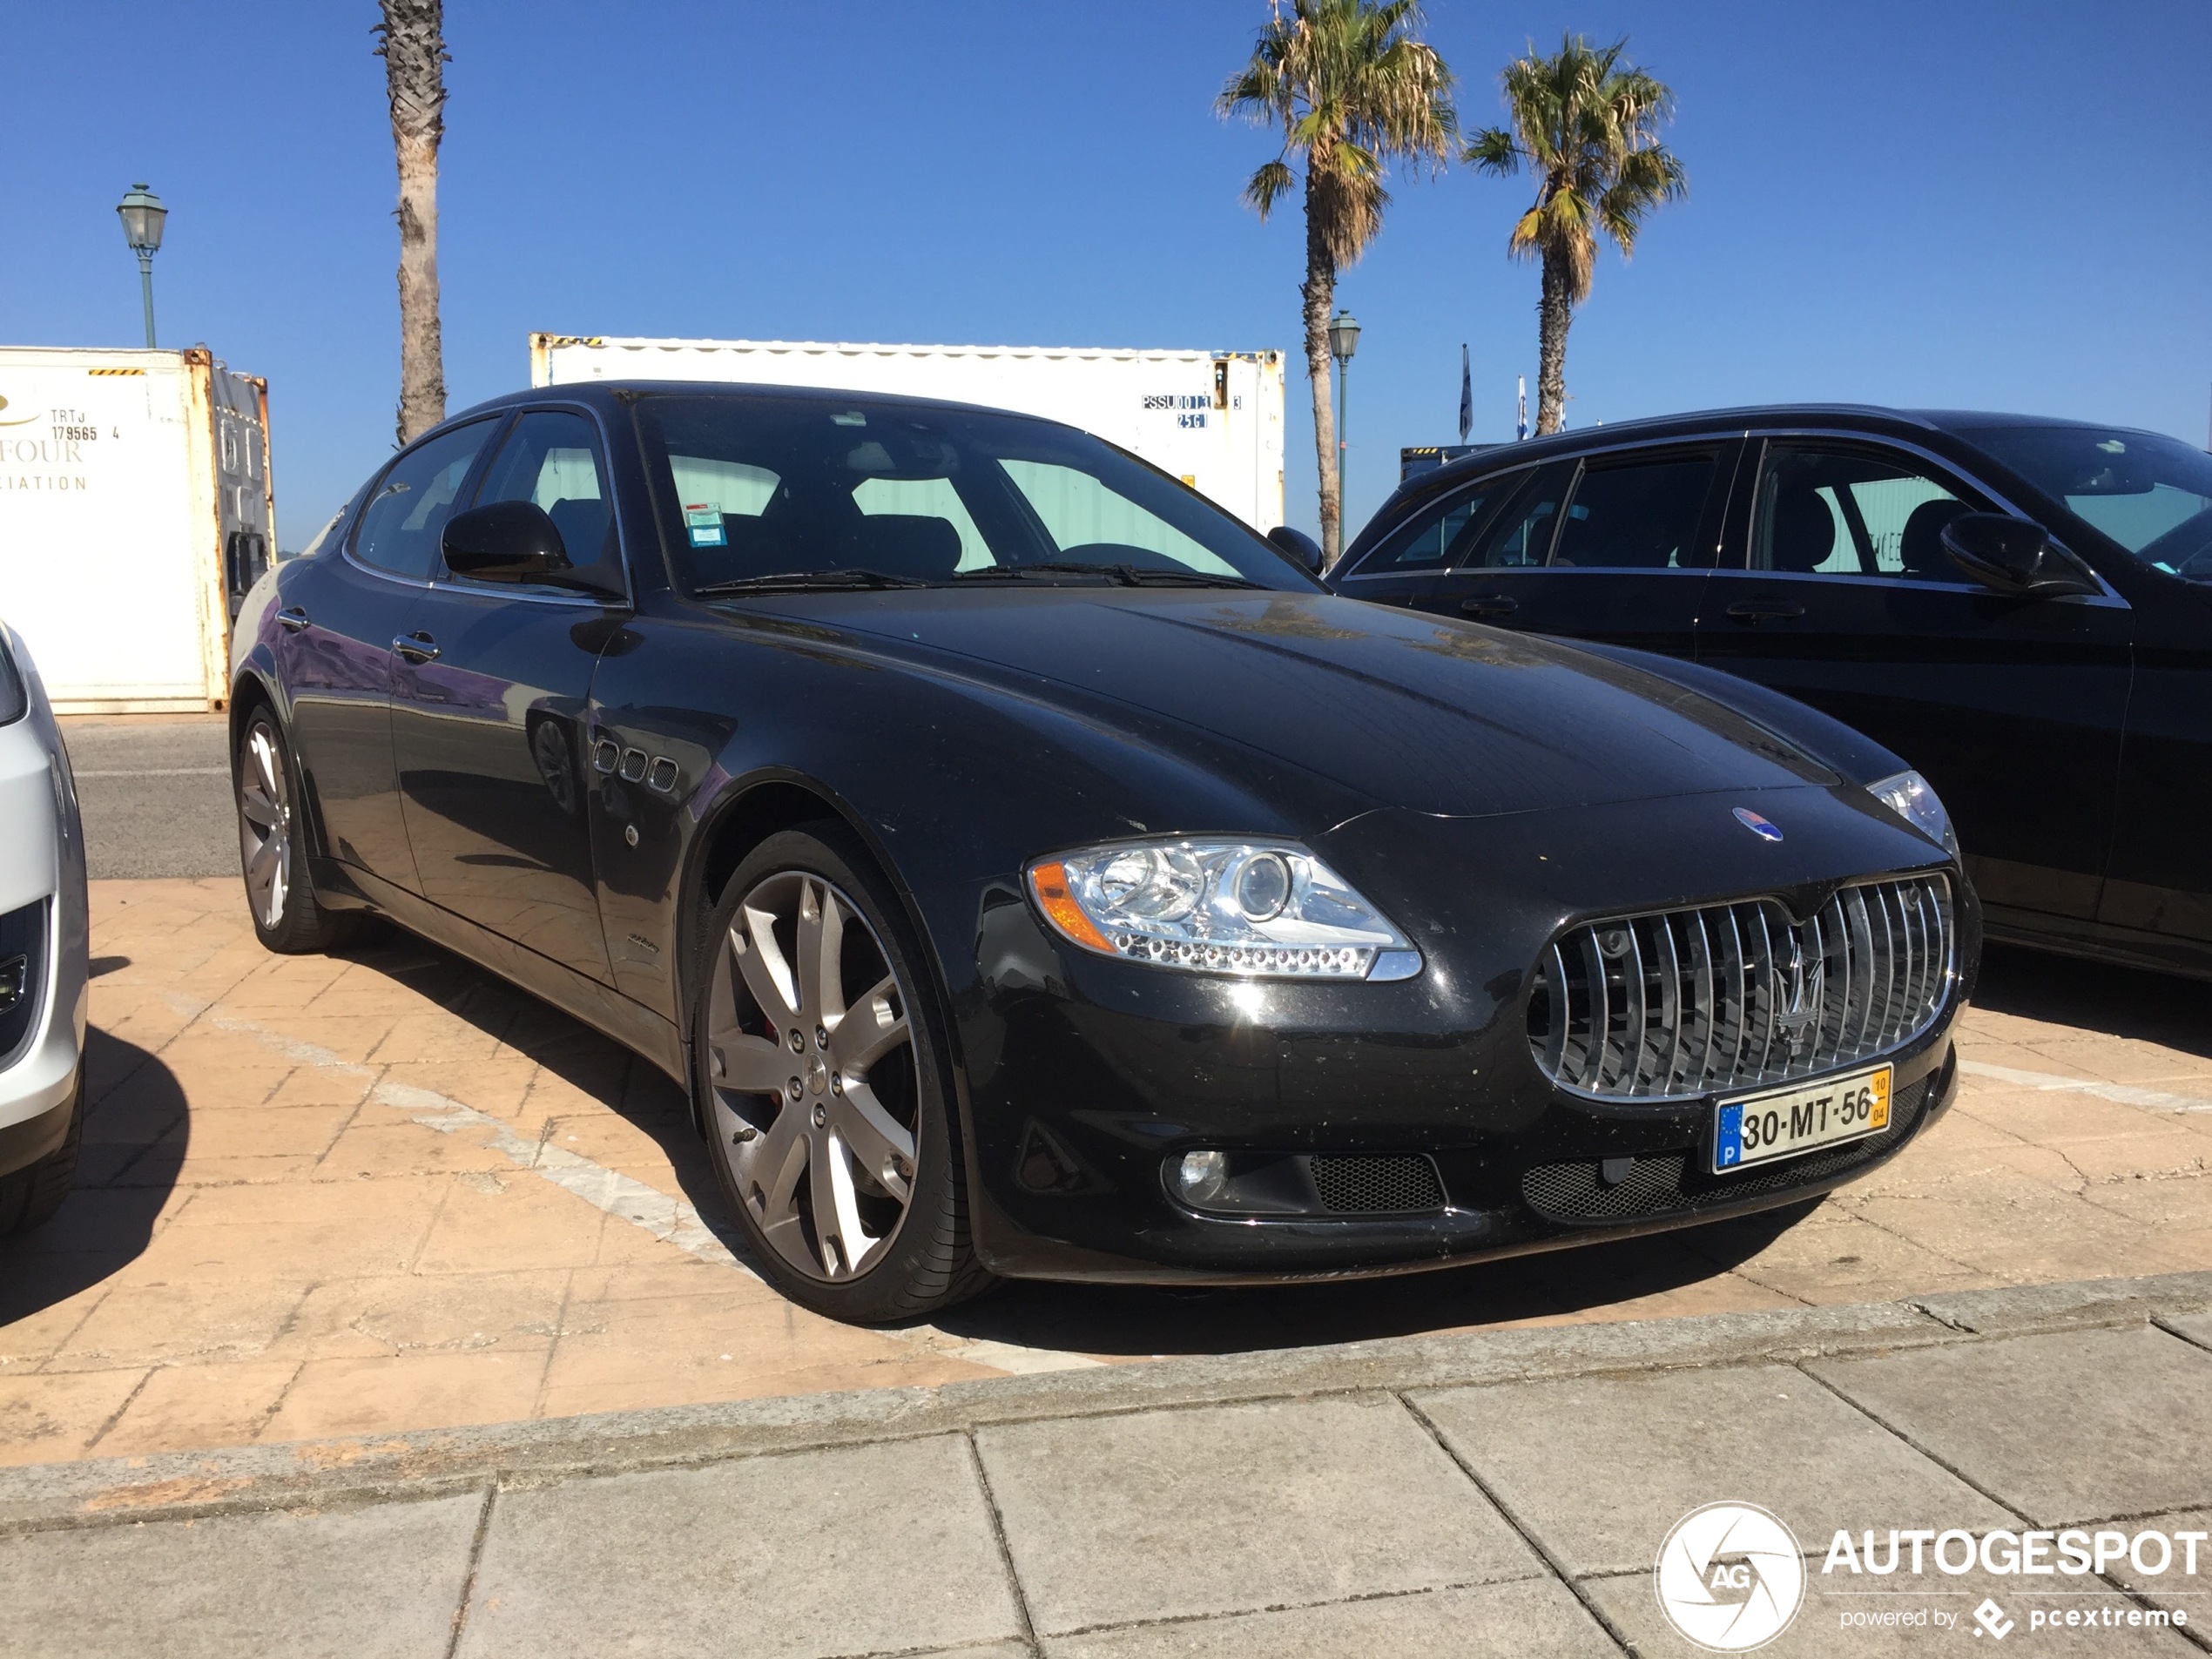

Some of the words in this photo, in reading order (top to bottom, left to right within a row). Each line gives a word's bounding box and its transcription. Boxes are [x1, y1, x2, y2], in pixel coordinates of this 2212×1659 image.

[1177, 414, 1207, 428] 25G1
[52, 427, 97, 441] 179565
[113, 426, 119, 440] 4
[1875, 1077, 1886, 1091] 10
[1873, 1107, 1885, 1122] 04
[1724, 1147, 1735, 1165] P
